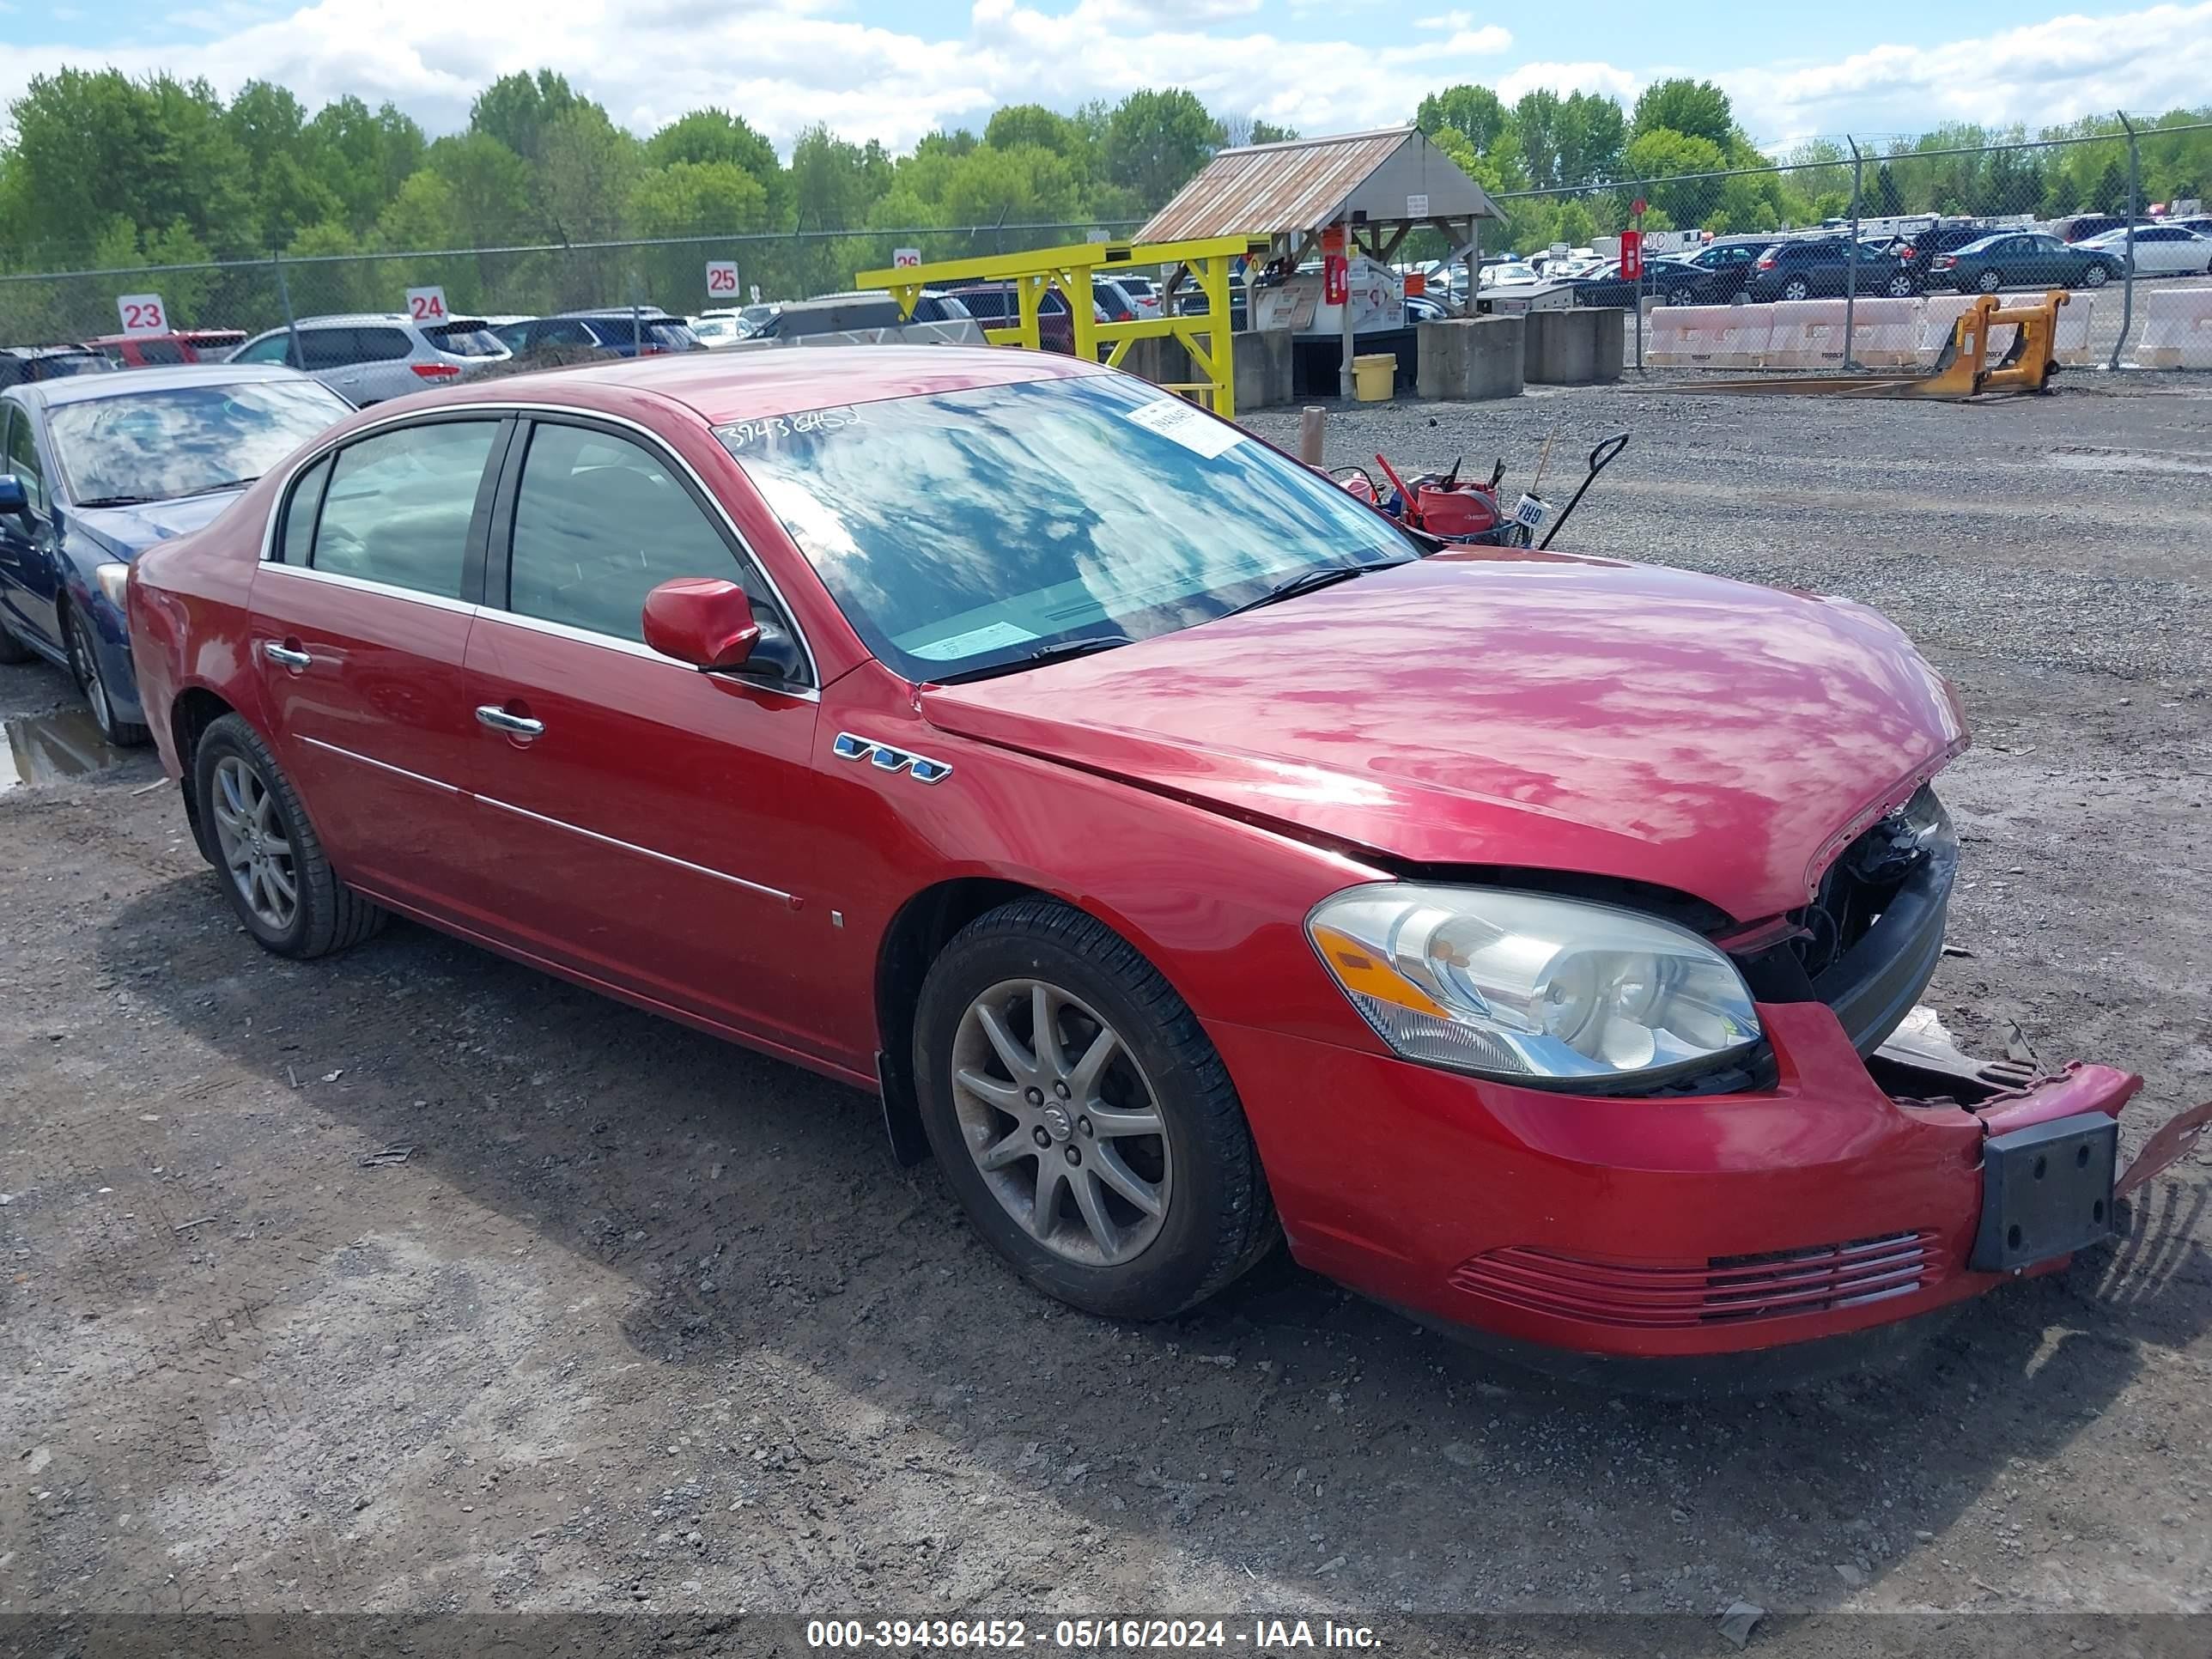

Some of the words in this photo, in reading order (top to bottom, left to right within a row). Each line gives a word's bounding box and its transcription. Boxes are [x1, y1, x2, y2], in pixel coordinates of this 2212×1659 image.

[710, 270, 735, 289] 25
[125, 304, 161, 328] 23
[412, 296, 443, 319] 24
[719, 408, 860, 447] 39436452
